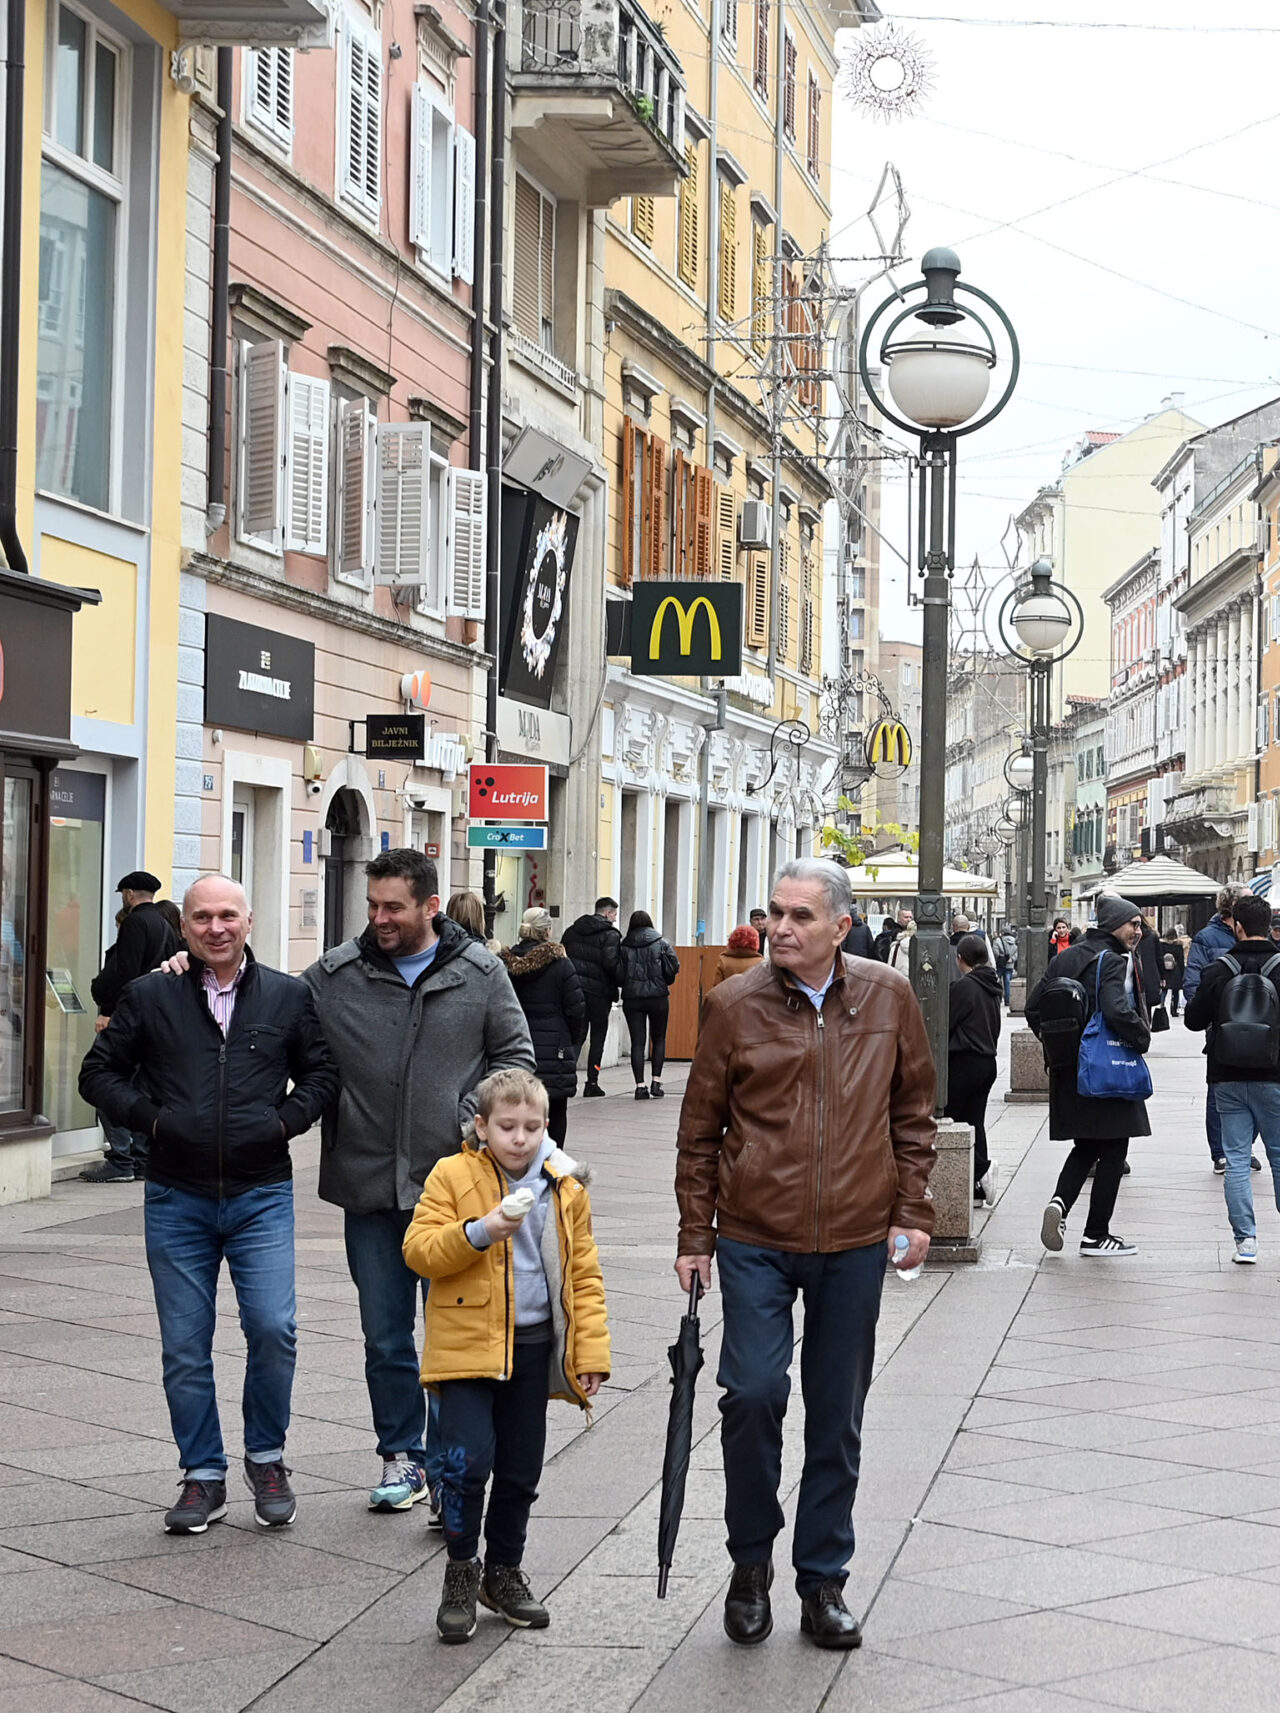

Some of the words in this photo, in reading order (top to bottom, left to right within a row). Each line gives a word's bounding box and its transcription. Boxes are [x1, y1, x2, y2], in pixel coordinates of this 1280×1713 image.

[382, 727, 408, 735] JAVNI
[371, 737, 419, 748] BILJEŽNIK
[491, 791, 539, 806] Lutrija
